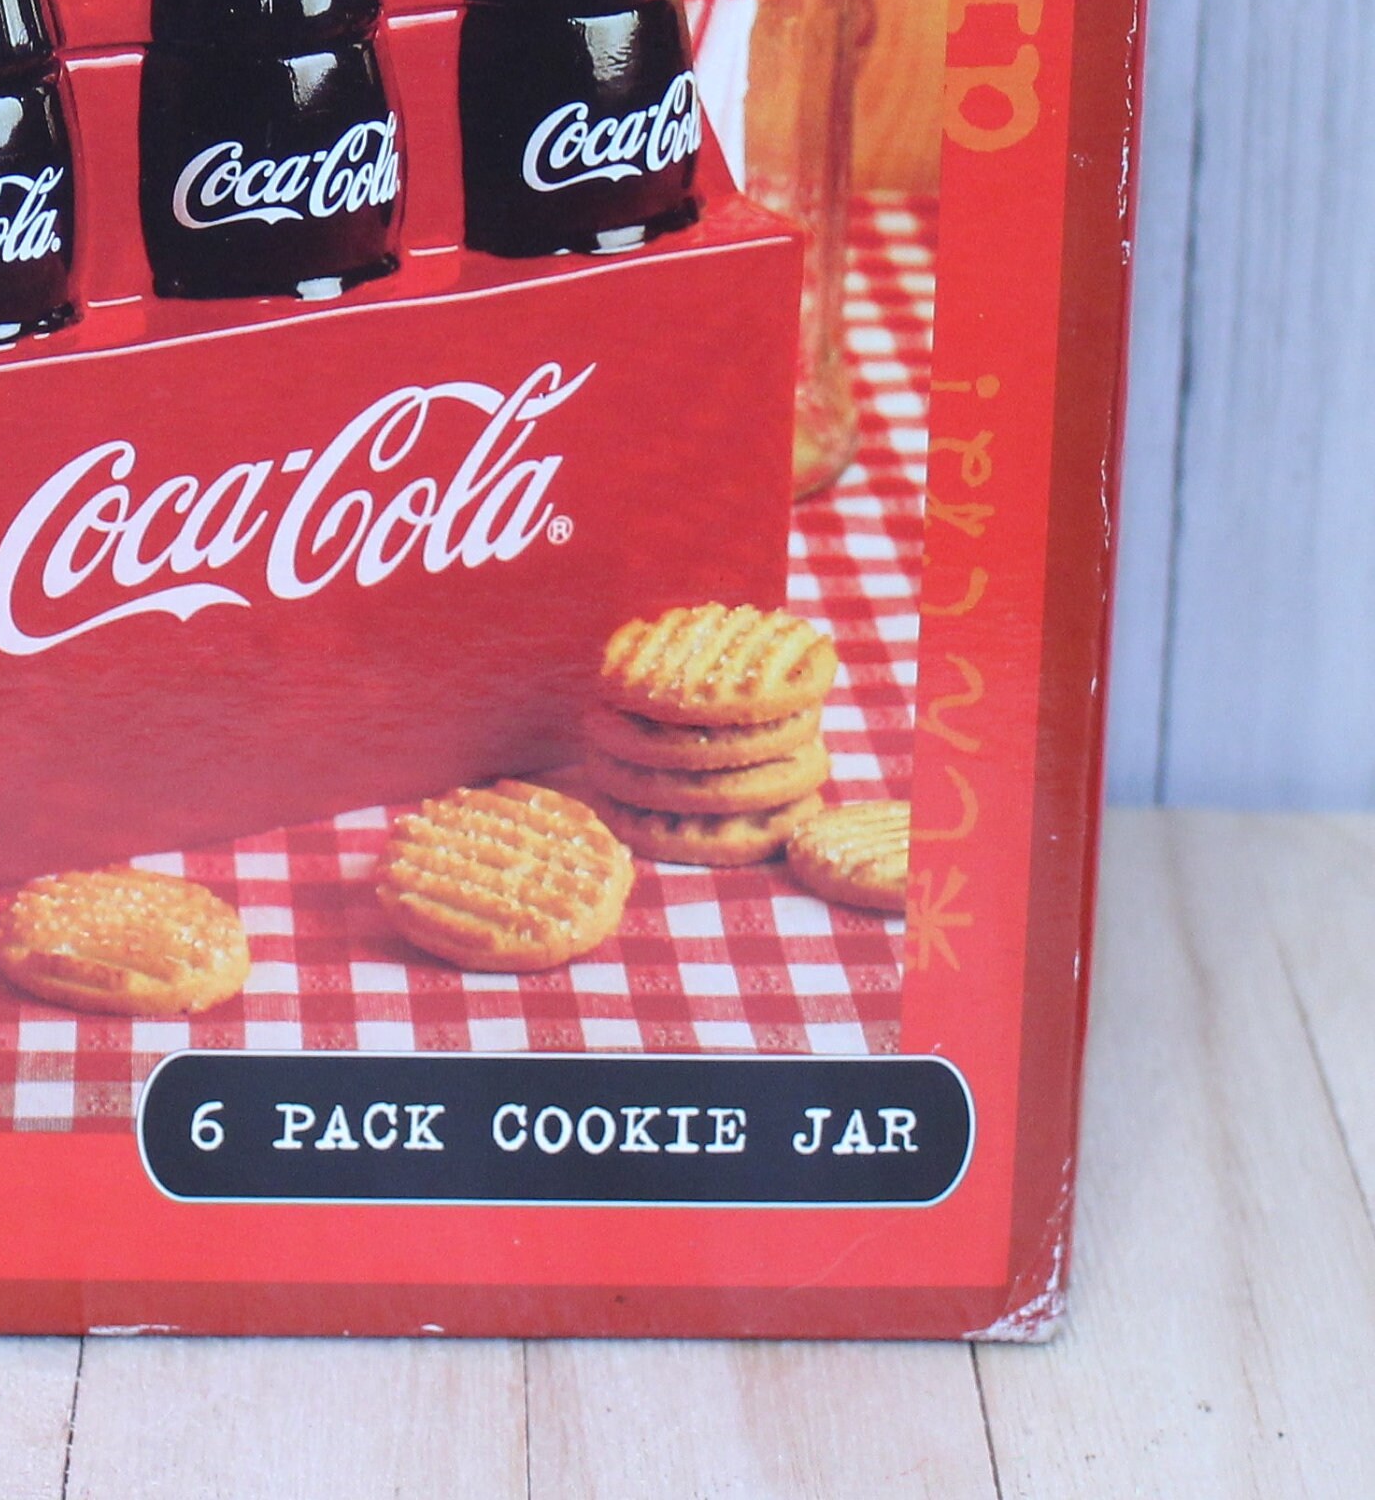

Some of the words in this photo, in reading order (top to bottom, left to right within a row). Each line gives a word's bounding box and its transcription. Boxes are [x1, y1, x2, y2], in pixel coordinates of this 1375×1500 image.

[172, 111, 400, 230] Coca-Cola
[188, 1099, 226, 1153] 6
[272, 1101, 446, 1152] PACK
[491, 1102, 748, 1156] COOKIE
[791, 1106, 921, 1157] JAR
